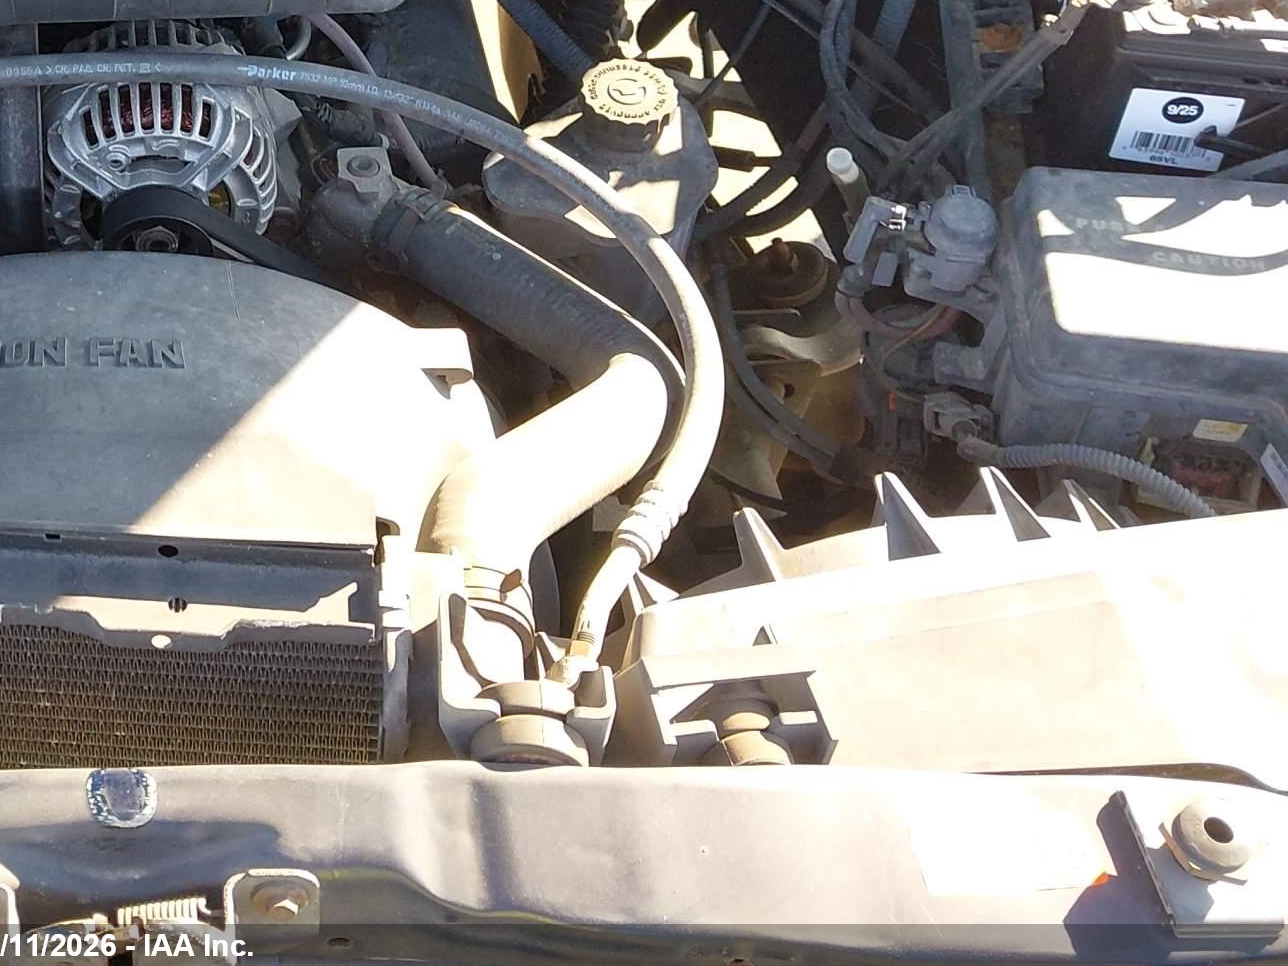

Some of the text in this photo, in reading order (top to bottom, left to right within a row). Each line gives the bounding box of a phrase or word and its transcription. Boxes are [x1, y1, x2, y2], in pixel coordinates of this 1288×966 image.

[240, 64, 297, 81] Parker
[1166, 103, 1200, 117] 9/25
[1151, 250, 1265, 271] CAUTION
[86, 336, 187, 370] FAN
